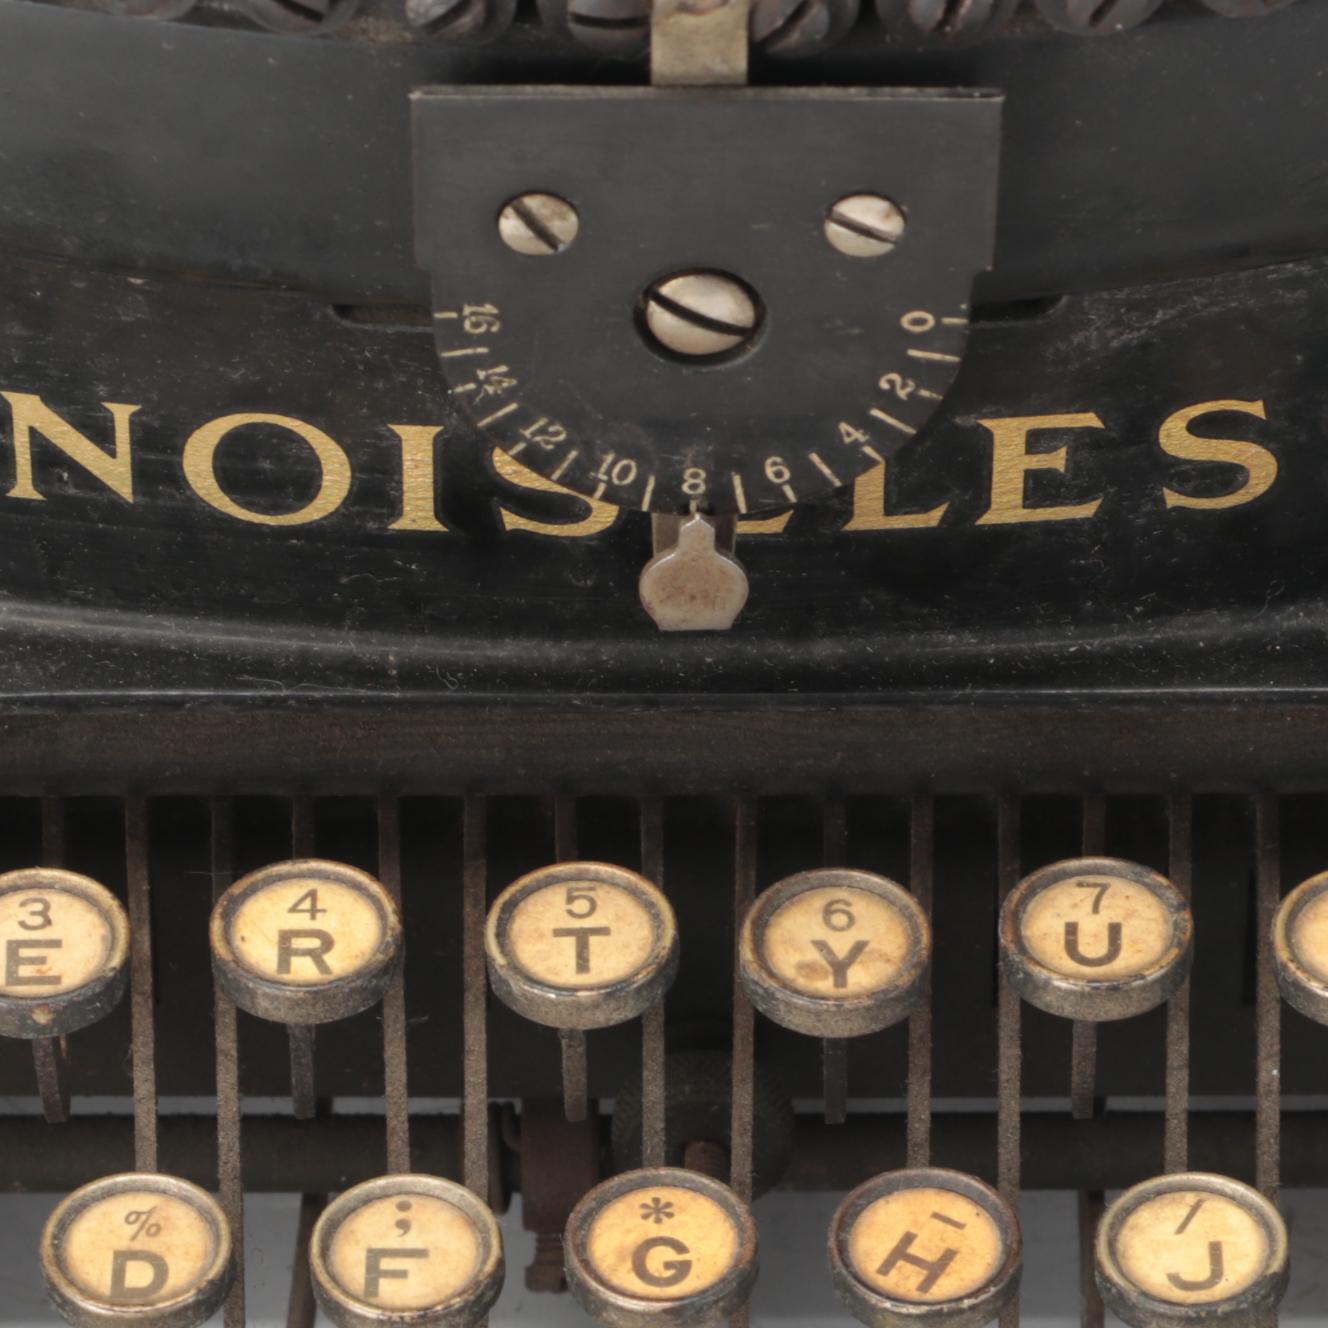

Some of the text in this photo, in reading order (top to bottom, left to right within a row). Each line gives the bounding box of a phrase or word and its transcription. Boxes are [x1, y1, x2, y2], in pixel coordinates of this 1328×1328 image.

[462, 302, 936, 494] 16 14 12 10 8 6 4 2 0
[18, 897, 52, 931] 3
[287, 888, 327, 920] 4
[565, 886, 597, 918] 5
[822, 899, 856, 931] 6
[1076, 882, 1111, 914] 7
[5, 939, 63, 987] E
[276, 928, 335, 975] R
[552, 926, 611, 974] T
[810, 940, 870, 988] Y
[1063, 922, 1122, 967] U
[124, 1205, 162, 1242] %
[110, 1249, 169, 1299] D
[363, 1248, 430, 1298] F
[631, 1236, 693, 1288] G
[876, 1231, 959, 1295] H
[1166, 1241, 1223, 1292] J
